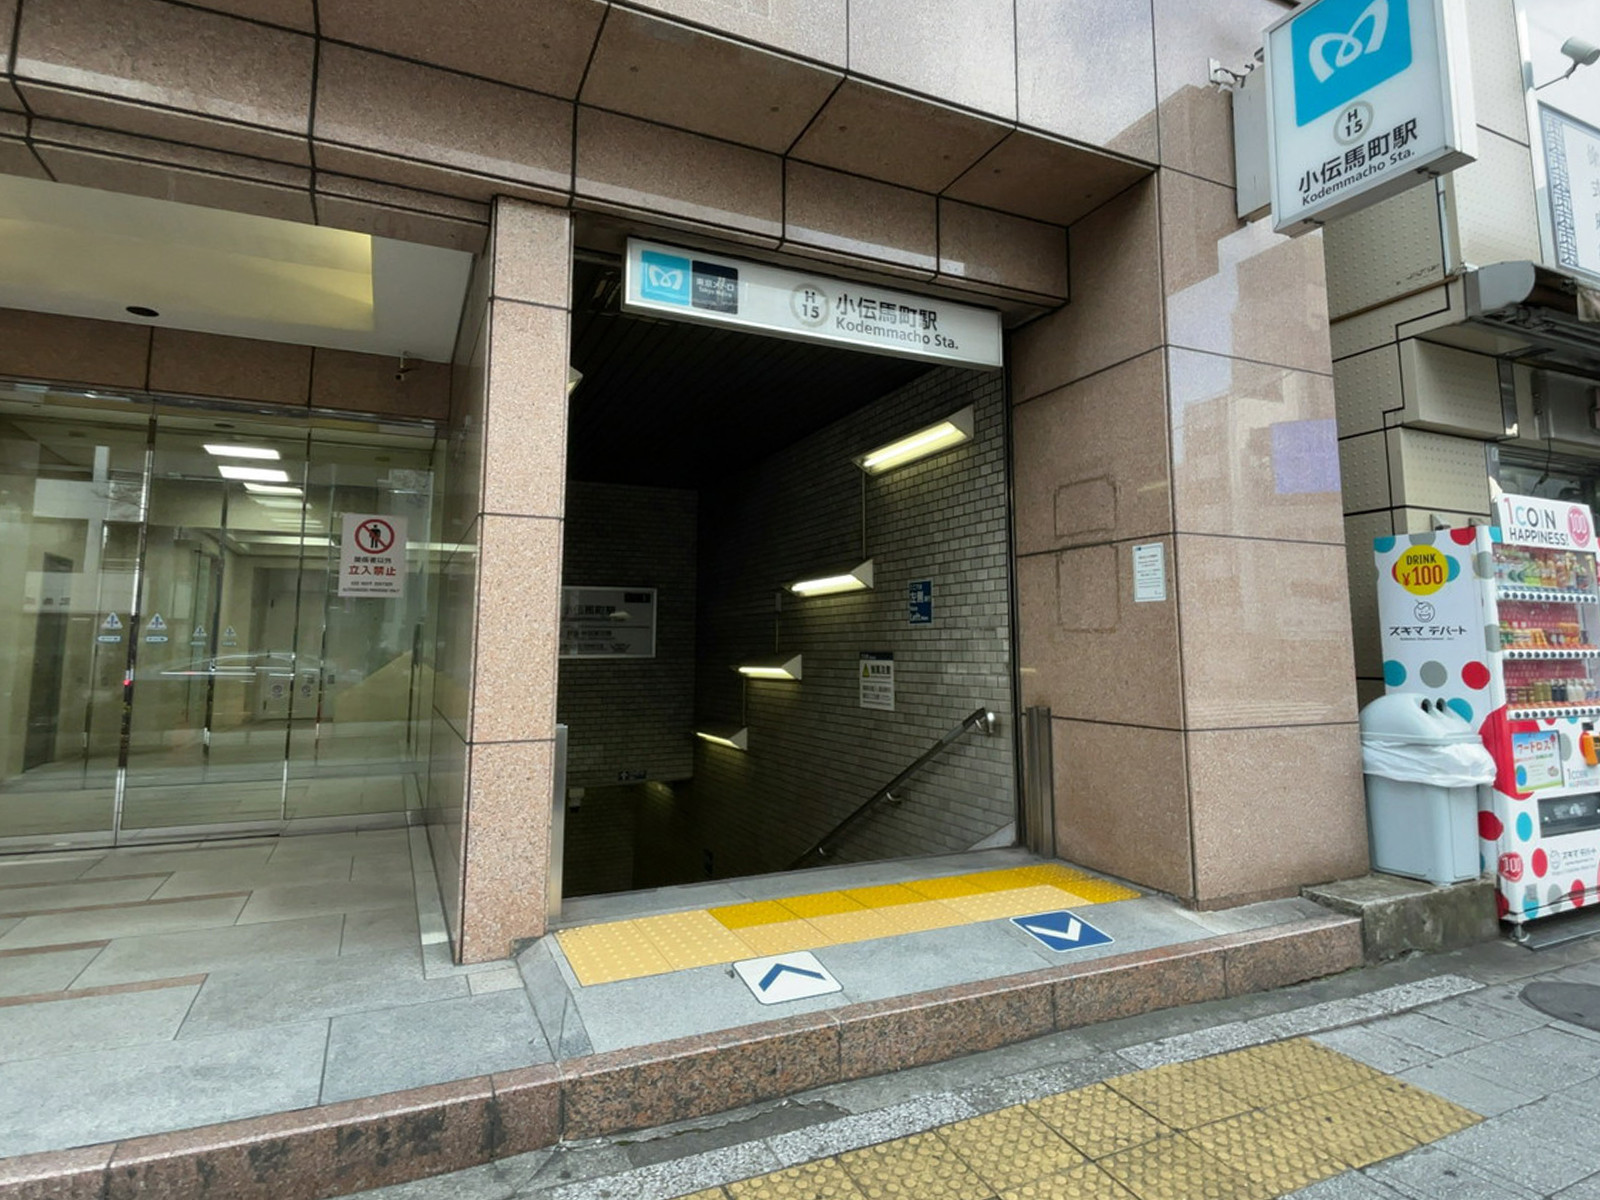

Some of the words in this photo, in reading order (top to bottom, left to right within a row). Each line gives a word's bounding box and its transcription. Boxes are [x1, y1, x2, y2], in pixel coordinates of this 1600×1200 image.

[1347, 108, 1358, 123] H
[1345, 119, 1363, 137] 15
[1298, 117, 1418, 194] 小伝馬町駅
[1302, 161, 1386, 206] Kodemmacho
[1389, 148, 1416, 166] Sta.
[804, 290, 816, 304] H
[801, 304, 820, 319] 15
[835, 293, 938, 331] 小伝馬町駅
[835, 316, 931, 345] Kodemmacho
[934, 334, 959, 350] Sta.
[1508, 527, 1570, 546] HAPPINESS!
[1406, 553, 1437, 566] DRINK
[348, 565, 397, 577] 立入禁止
